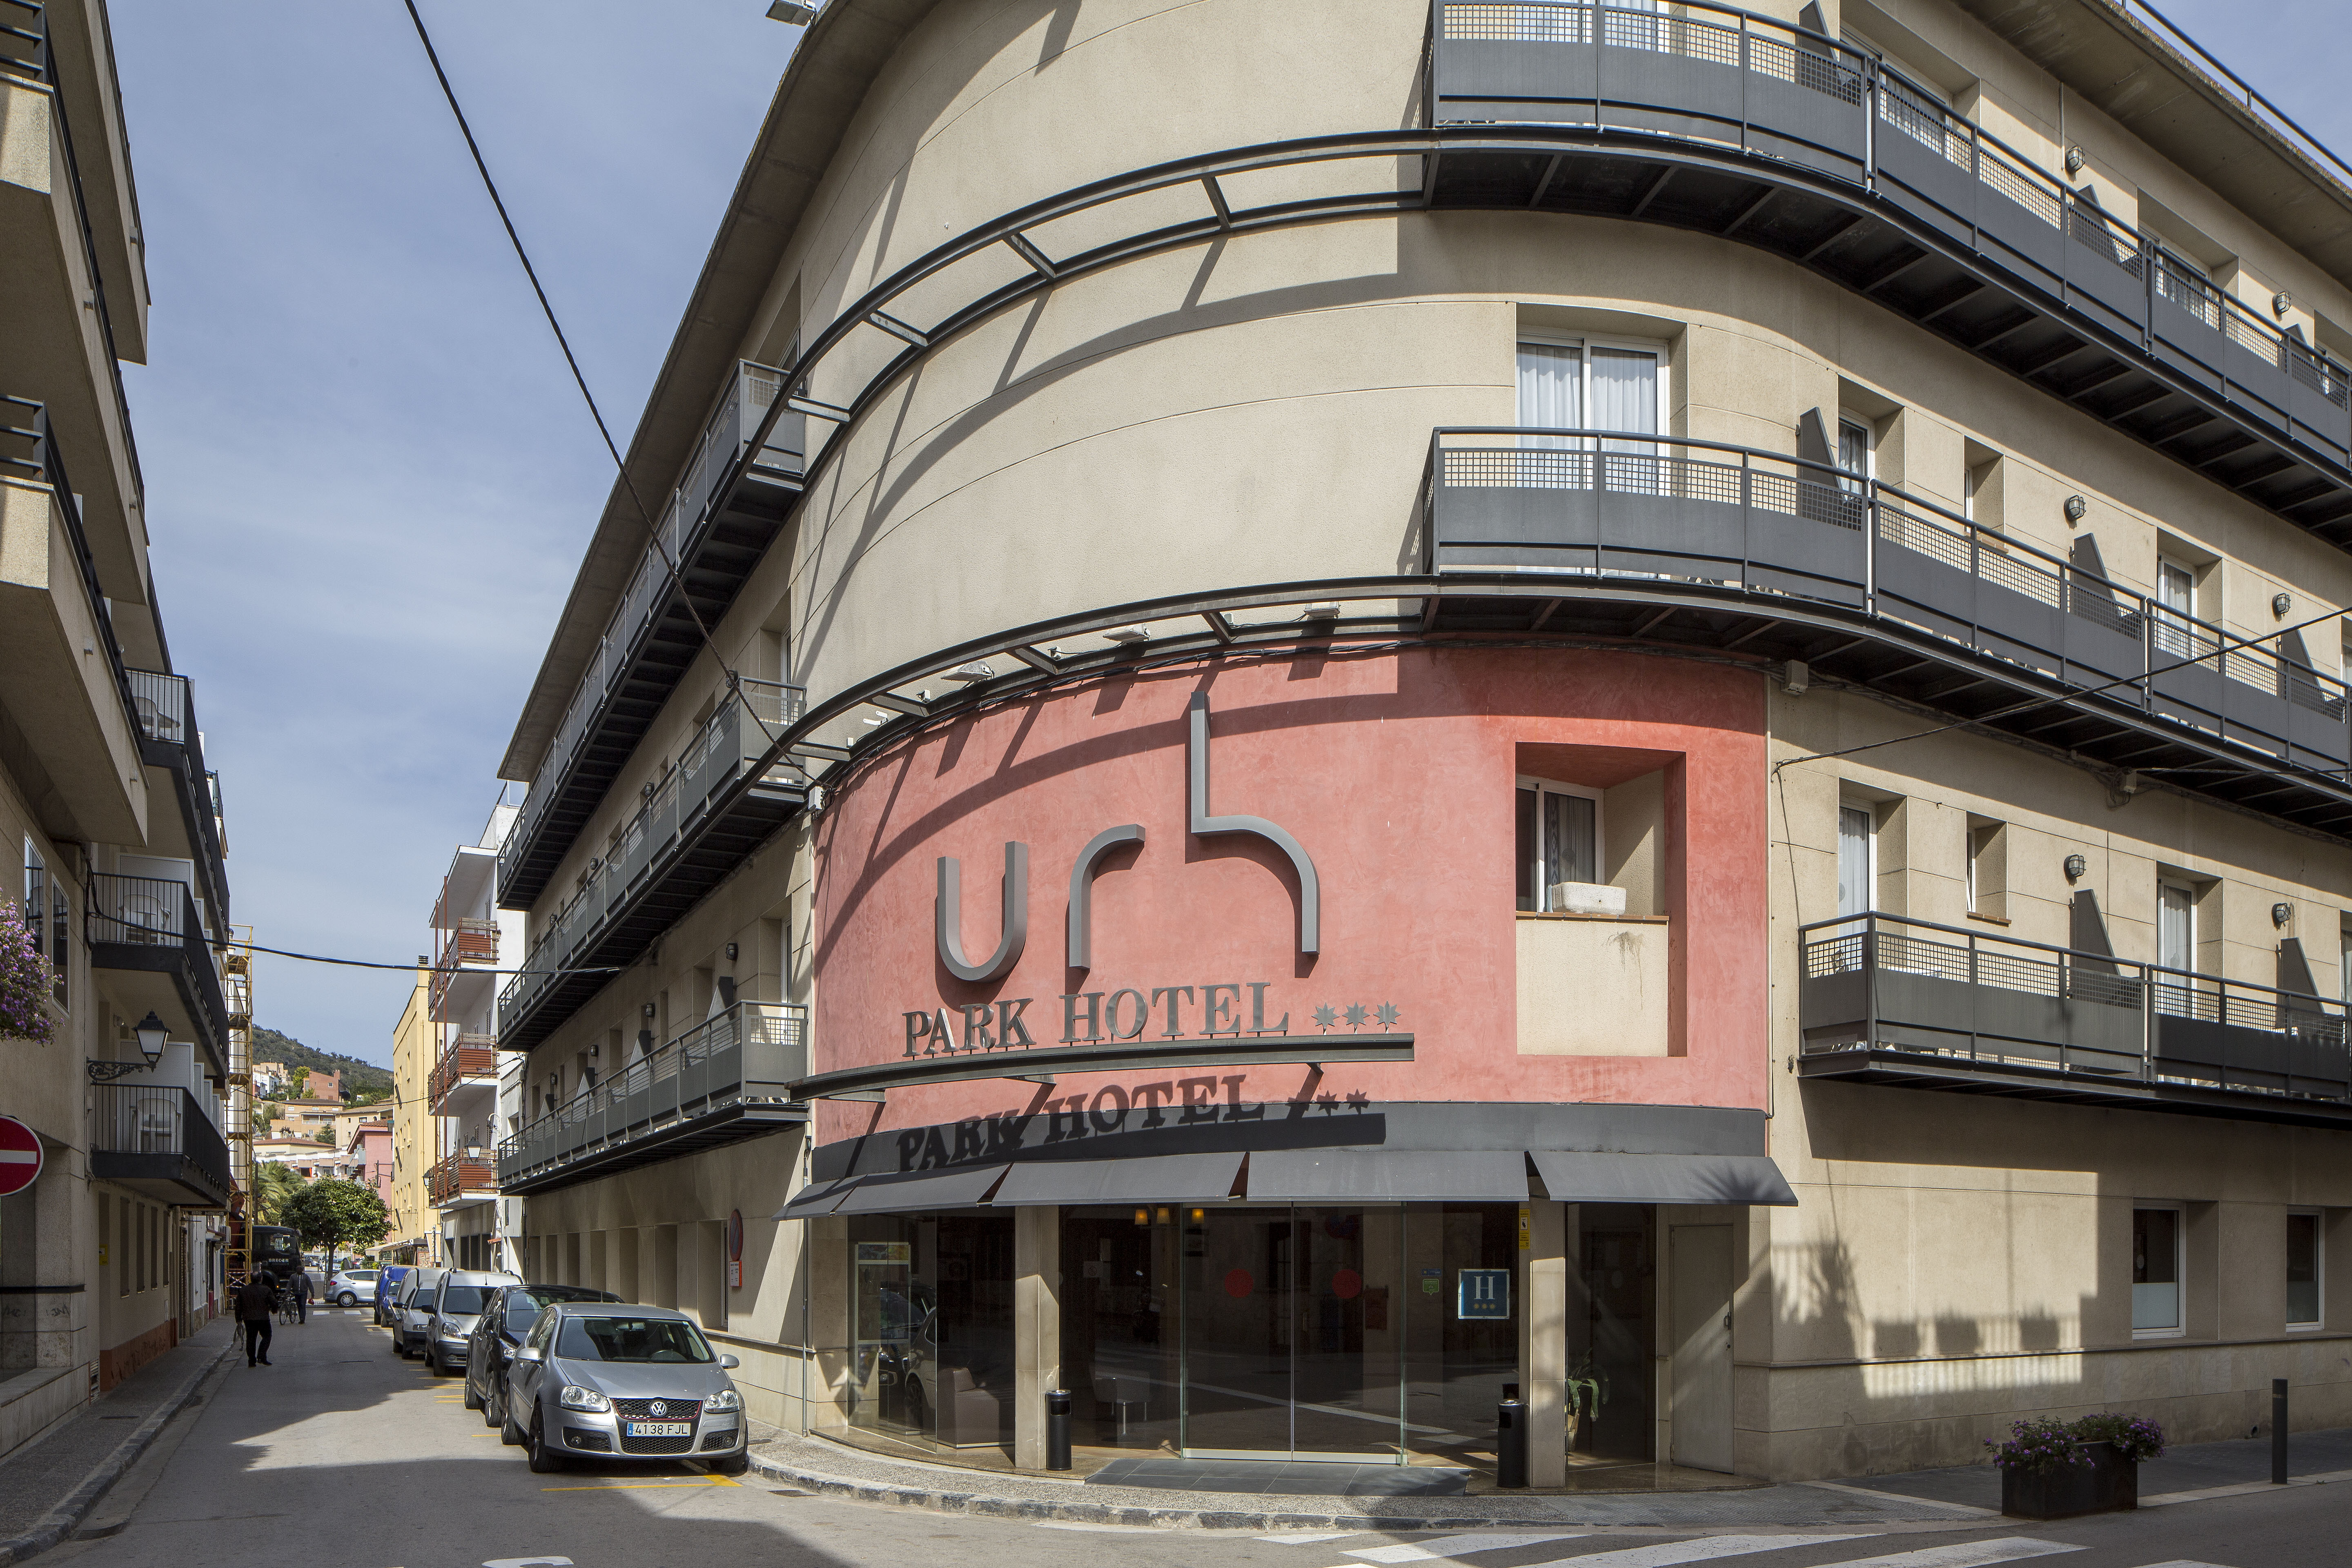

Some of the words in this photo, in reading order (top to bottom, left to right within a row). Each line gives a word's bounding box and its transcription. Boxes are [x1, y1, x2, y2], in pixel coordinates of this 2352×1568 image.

[902, 998, 1037, 1057] PARK
[1059, 982, 1289, 1044] HOTEL
[1474, 1276, 1495, 1299] H
[635, 1424, 663, 1435] 4138
[667, 1424, 688, 1434] FJL
